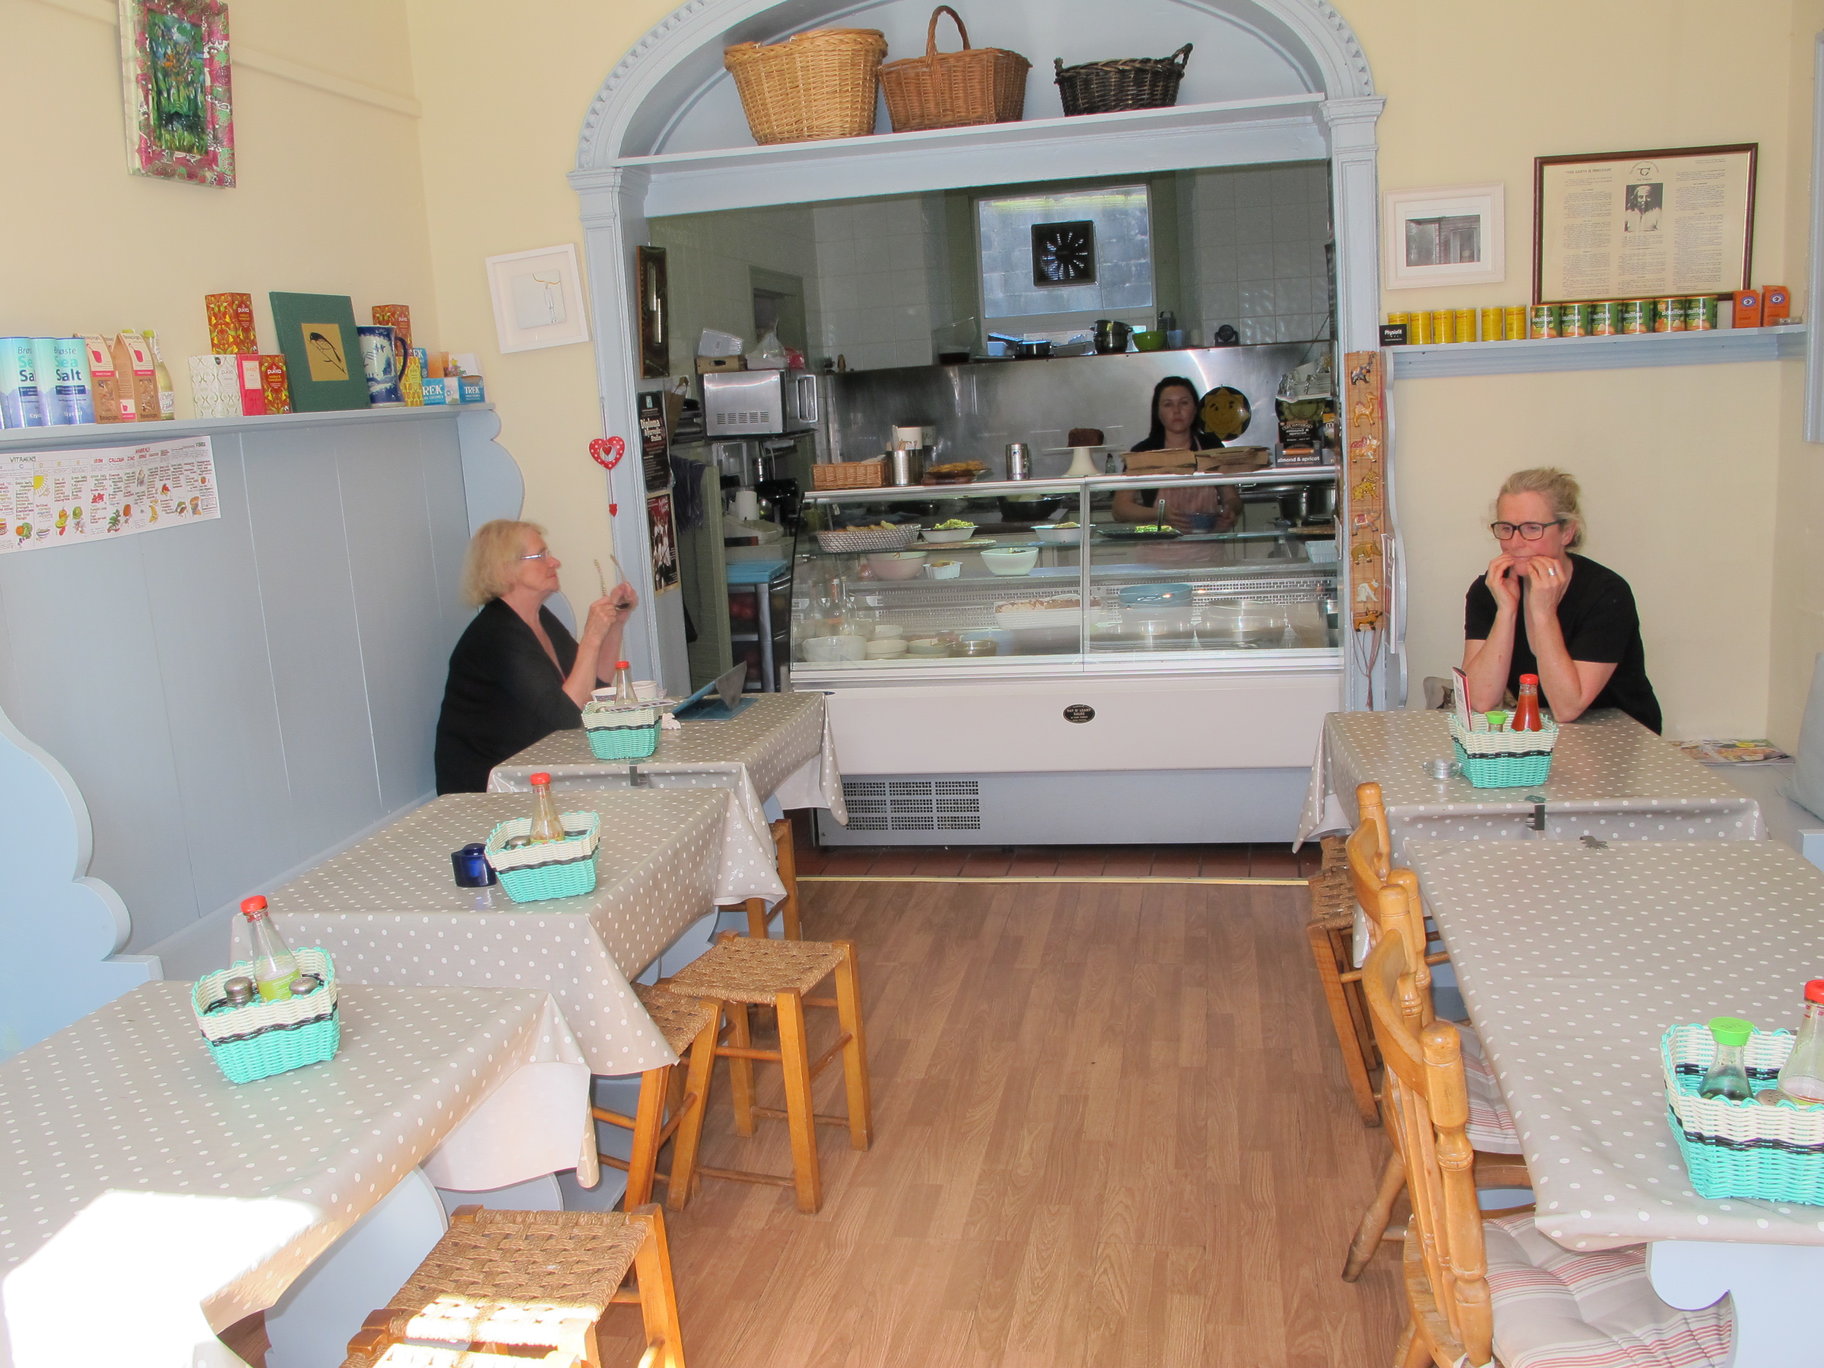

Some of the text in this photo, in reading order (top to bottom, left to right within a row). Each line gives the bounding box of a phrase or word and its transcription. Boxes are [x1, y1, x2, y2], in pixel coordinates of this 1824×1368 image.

[55, 368, 82, 381] Salt
[422, 384, 443, 396] REK
[463, 385, 481, 395] TREK
